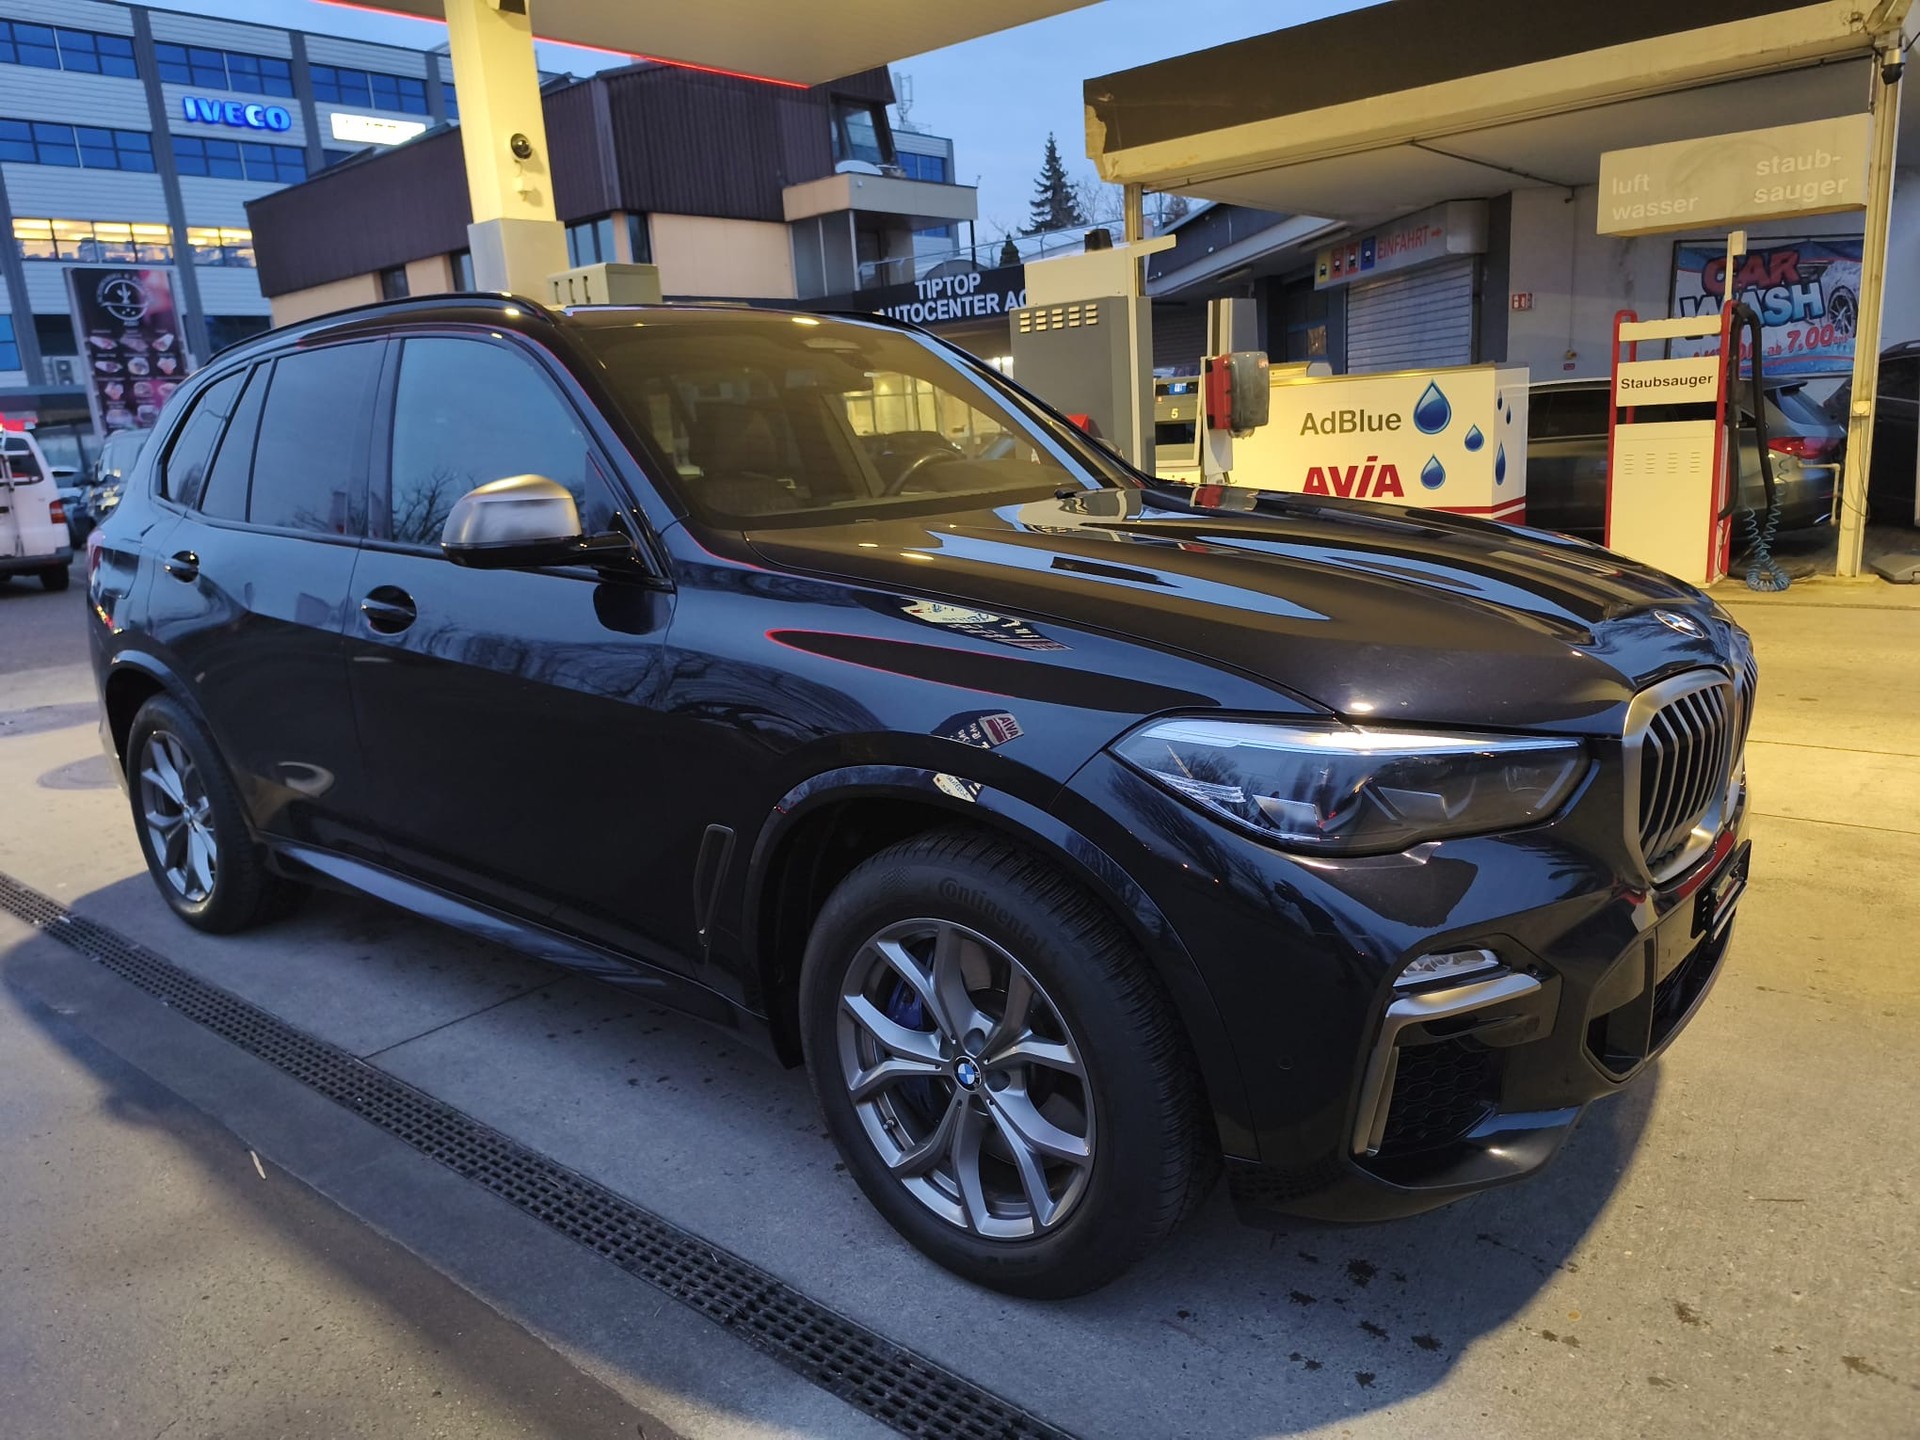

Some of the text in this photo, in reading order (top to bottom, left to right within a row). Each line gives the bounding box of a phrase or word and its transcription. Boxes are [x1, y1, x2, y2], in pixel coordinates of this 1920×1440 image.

[183, 97, 291, 132] IVECO
[1756, 149, 1842, 176] staub-
[1611, 174, 1650, 196] luft
[1753, 176, 1849, 203] sauger
[1612, 195, 1698, 220] wasser
[1377, 225, 1429, 259] EINFAHRT
[915, 273, 981, 299] TIPTOP
[1702, 251, 1800, 294] CAR
[1786, 324, 1835, 354] 7.00
[1620, 375, 1713, 390] Staubsauger
[1171, 407, 1179, 419] 5
[1300, 409, 1402, 436] AdBlue
